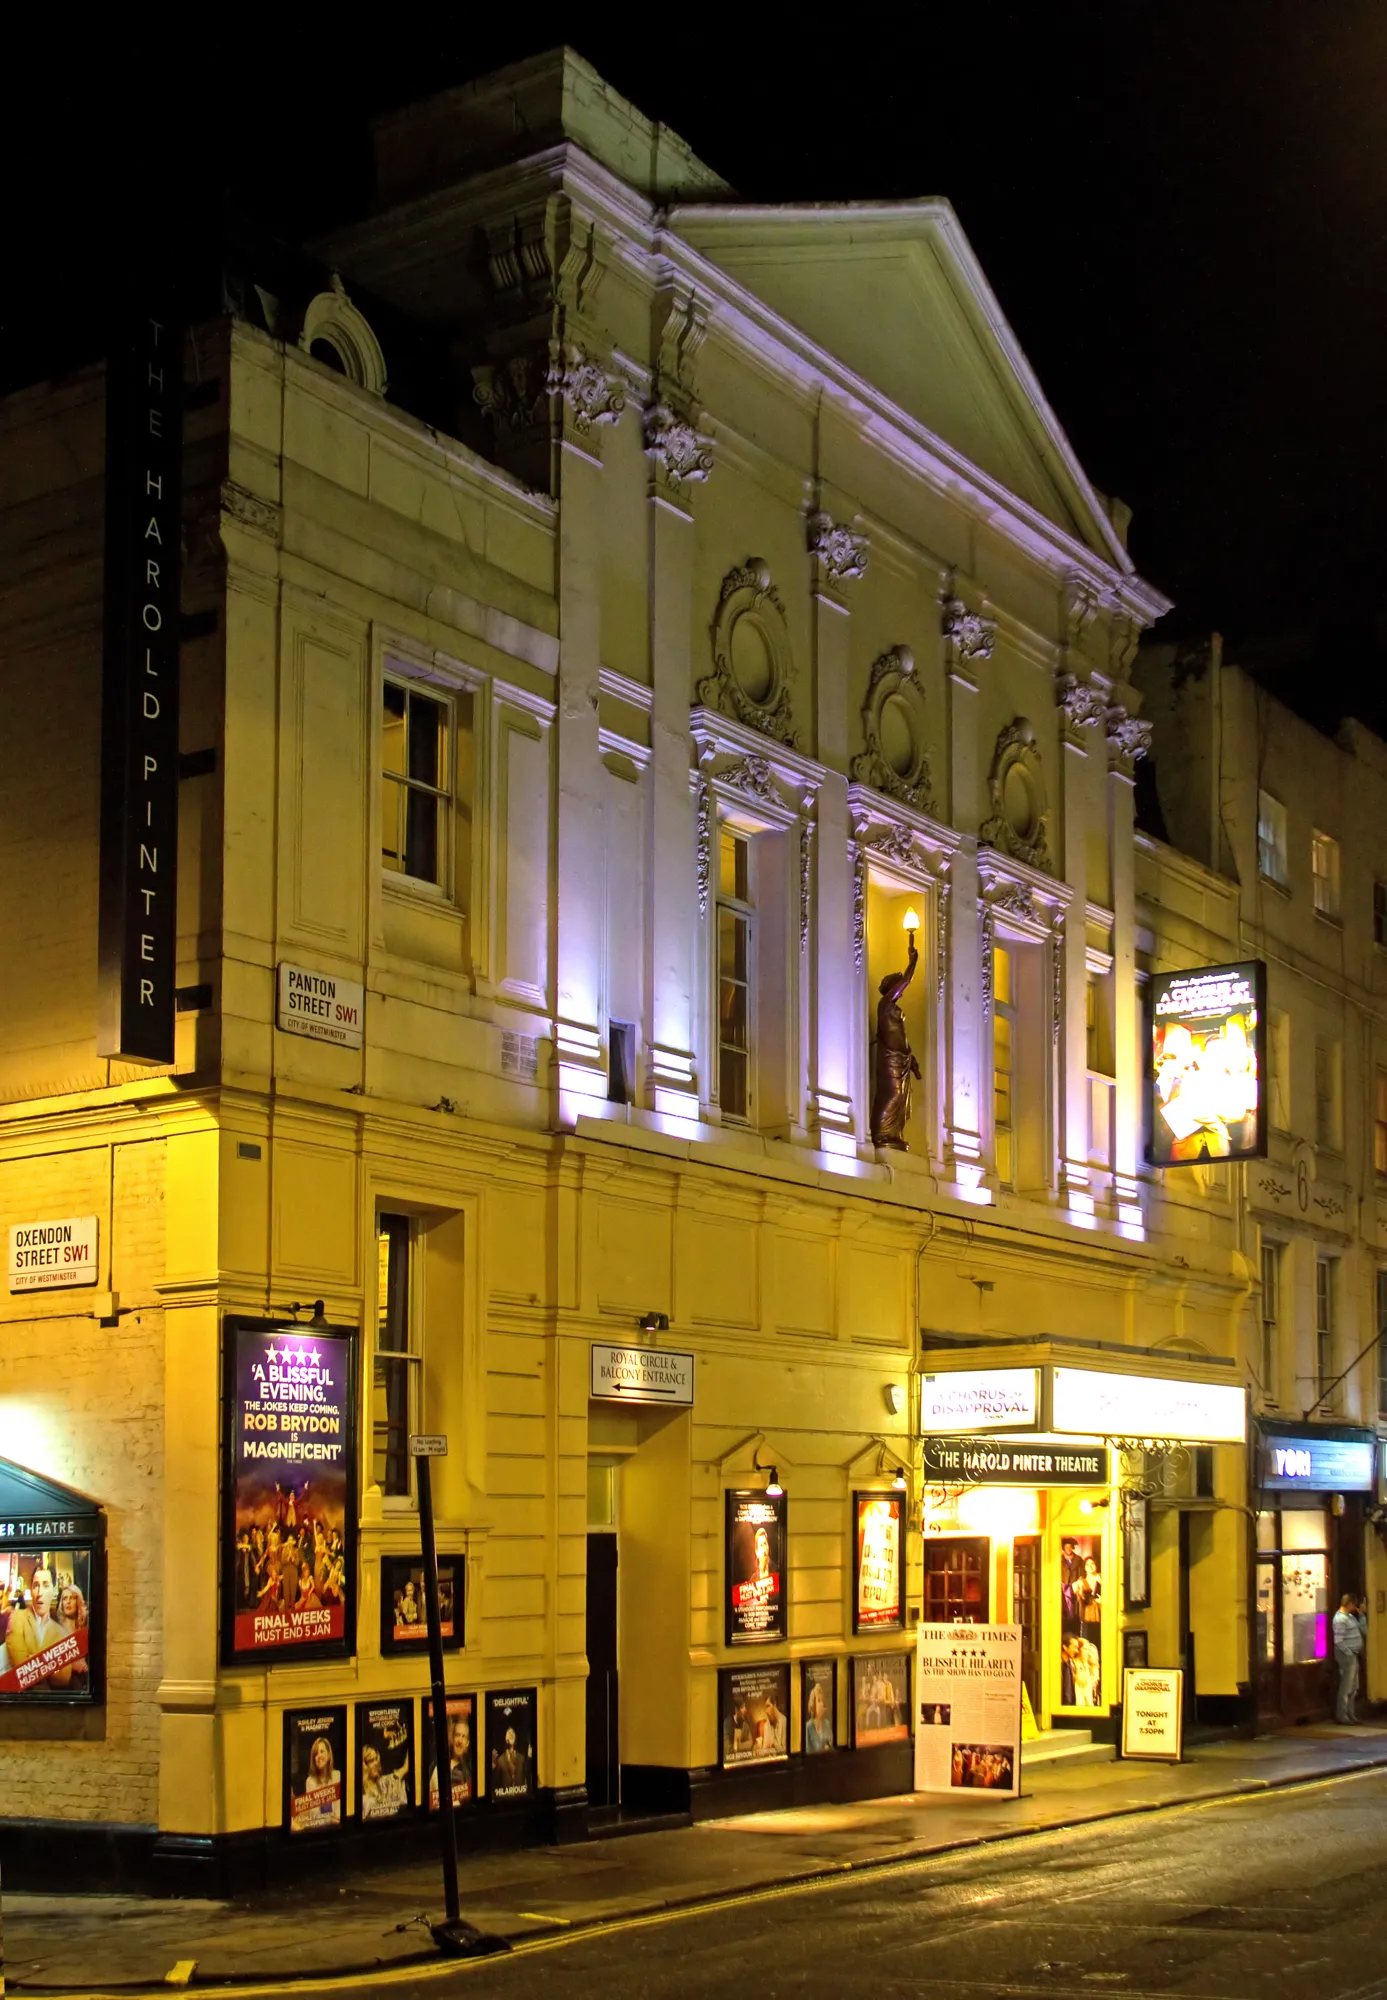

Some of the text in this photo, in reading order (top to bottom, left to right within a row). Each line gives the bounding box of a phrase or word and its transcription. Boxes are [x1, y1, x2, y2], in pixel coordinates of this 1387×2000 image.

[139, 317, 165, 1007] THE HAROLD PINTER
[288, 970, 336, 999] PANTON
[288, 991, 357, 1025] STREET SW1
[287, 1018, 347, 1040] CITY OF WESTMINSTER
[16, 1225, 72, 1248] OXENDON
[16, 1244, 88, 1268] STREET SW1
[15, 1271, 77, 1285] CITY OF WESTMINSTER
[610, 1351, 677, 1370] ROYAL CIRCLE &
[269, 1364, 334, 1386] BLISSFUL
[600, 1365, 686, 1385] BALCONY ENTRANCE
[260, 1382, 327, 1403] EVENING.
[244, 1400, 340, 1415] THE JOKES KEEP COMING.
[932, 1401, 1029, 1415] DISAPPROVAL
[244, 1413, 340, 1434] ROB BRYDON
[291, 1432, 299, 1442] IS
[939, 1451, 1099, 1473] THE HAROLD PINTER THEATRE
[19, 1521, 75, 1535] THEATRE
[254, 1609, 331, 1631] FINAL WEEKS
[254, 1623, 331, 1643] MUST END 5 JAN
[922, 1629, 1017, 1641] THE TIMES
[16, 1636, 77, 1679] FINAL WEEKS
[19, 1646, 80, 1689] MUST END 5 JAN
[922, 1657, 1015, 1671] BLISSFUL HILARITY
[924, 1668, 931, 1676] AS
[932, 1668, 945, 1676] THE
[947, 1668, 967, 1677] SHOW
[968, 1669, 982, 1677] HAS
[983, 1669, 993, 1677] TO
[993, 1670, 1004, 1678] GO
[1136, 1710, 1169, 1718] TONIGHT
[1147, 1719, 1156, 1727] AT
[1139, 1727, 1165, 1735] 7.30PM
[295, 1786, 336, 1806] FINAL WEEKS
